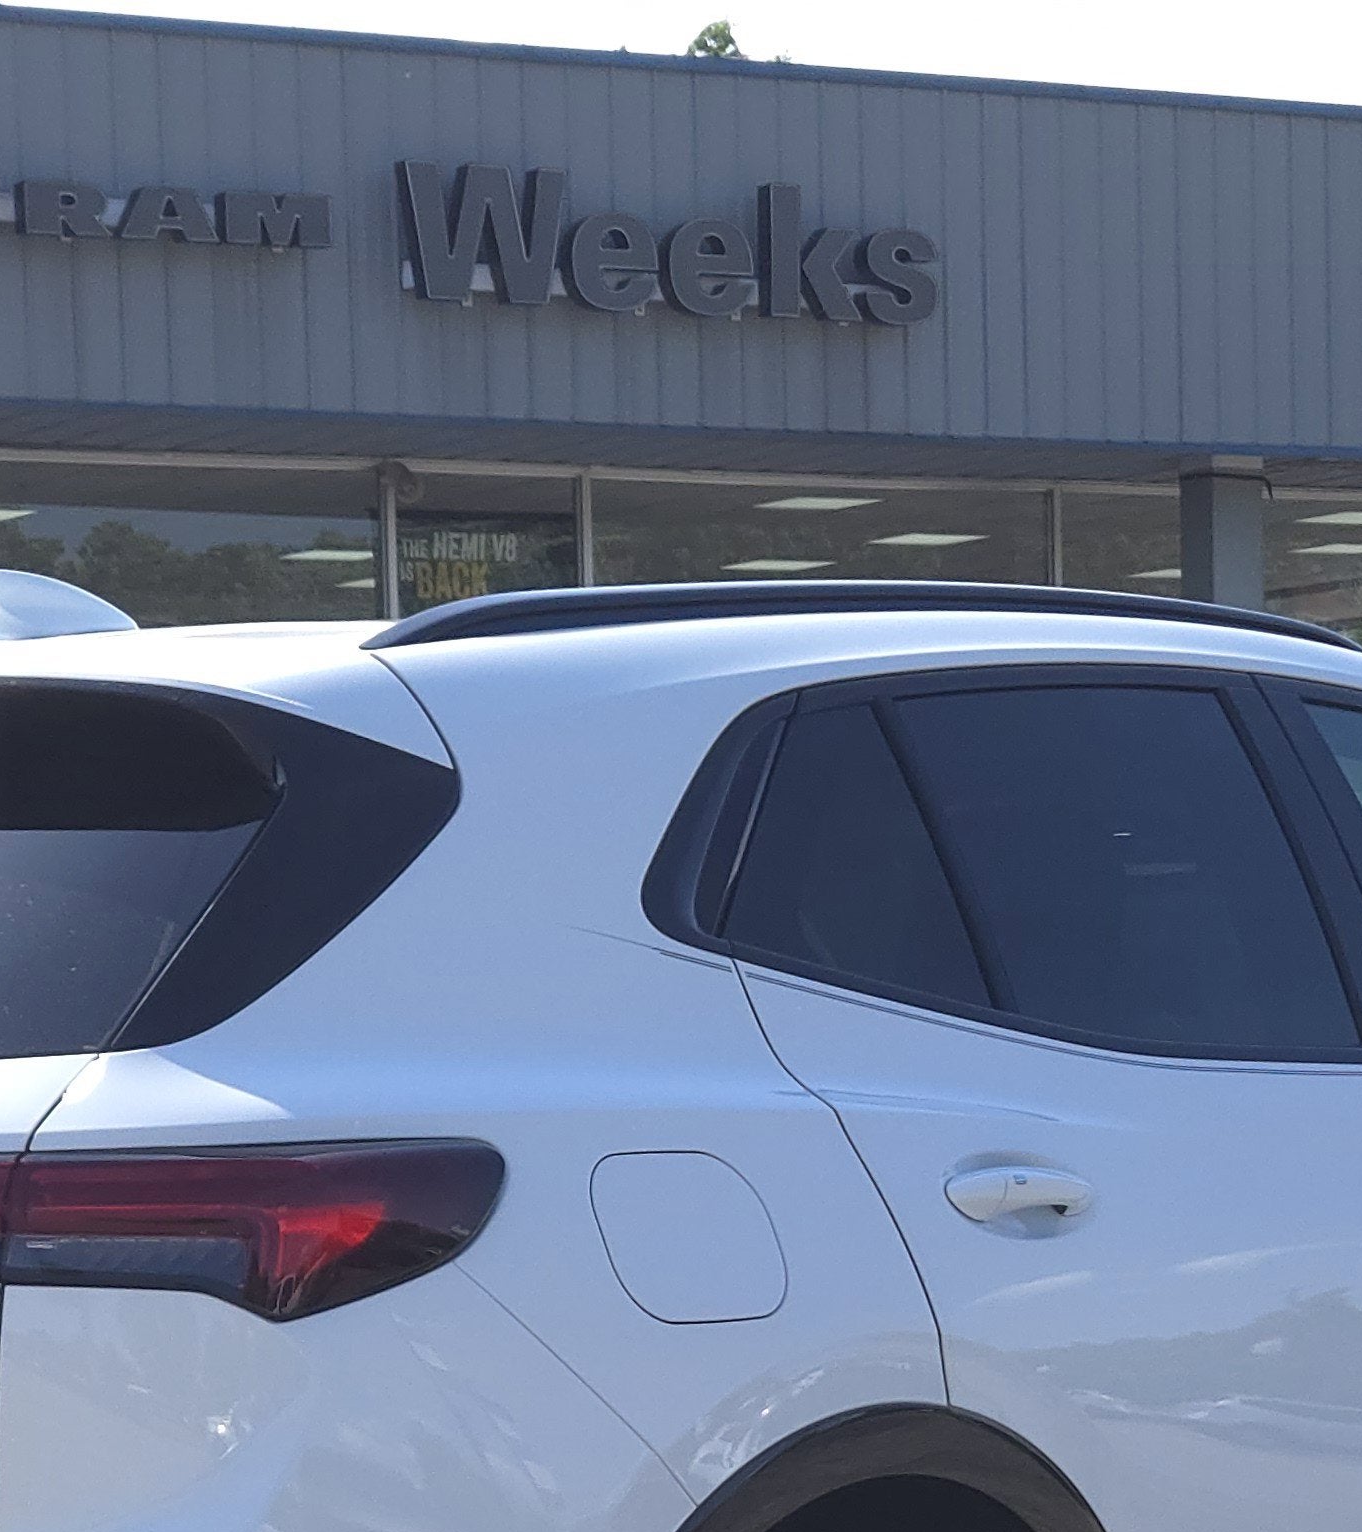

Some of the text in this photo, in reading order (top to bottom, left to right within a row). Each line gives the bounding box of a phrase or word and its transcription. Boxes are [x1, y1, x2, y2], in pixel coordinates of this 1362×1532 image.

[16, 181, 333, 249] RAM
[395, 160, 939, 326] Weeks
[400, 530, 517, 562] THE HEMI V8
[415, 560, 488, 600] BACK
